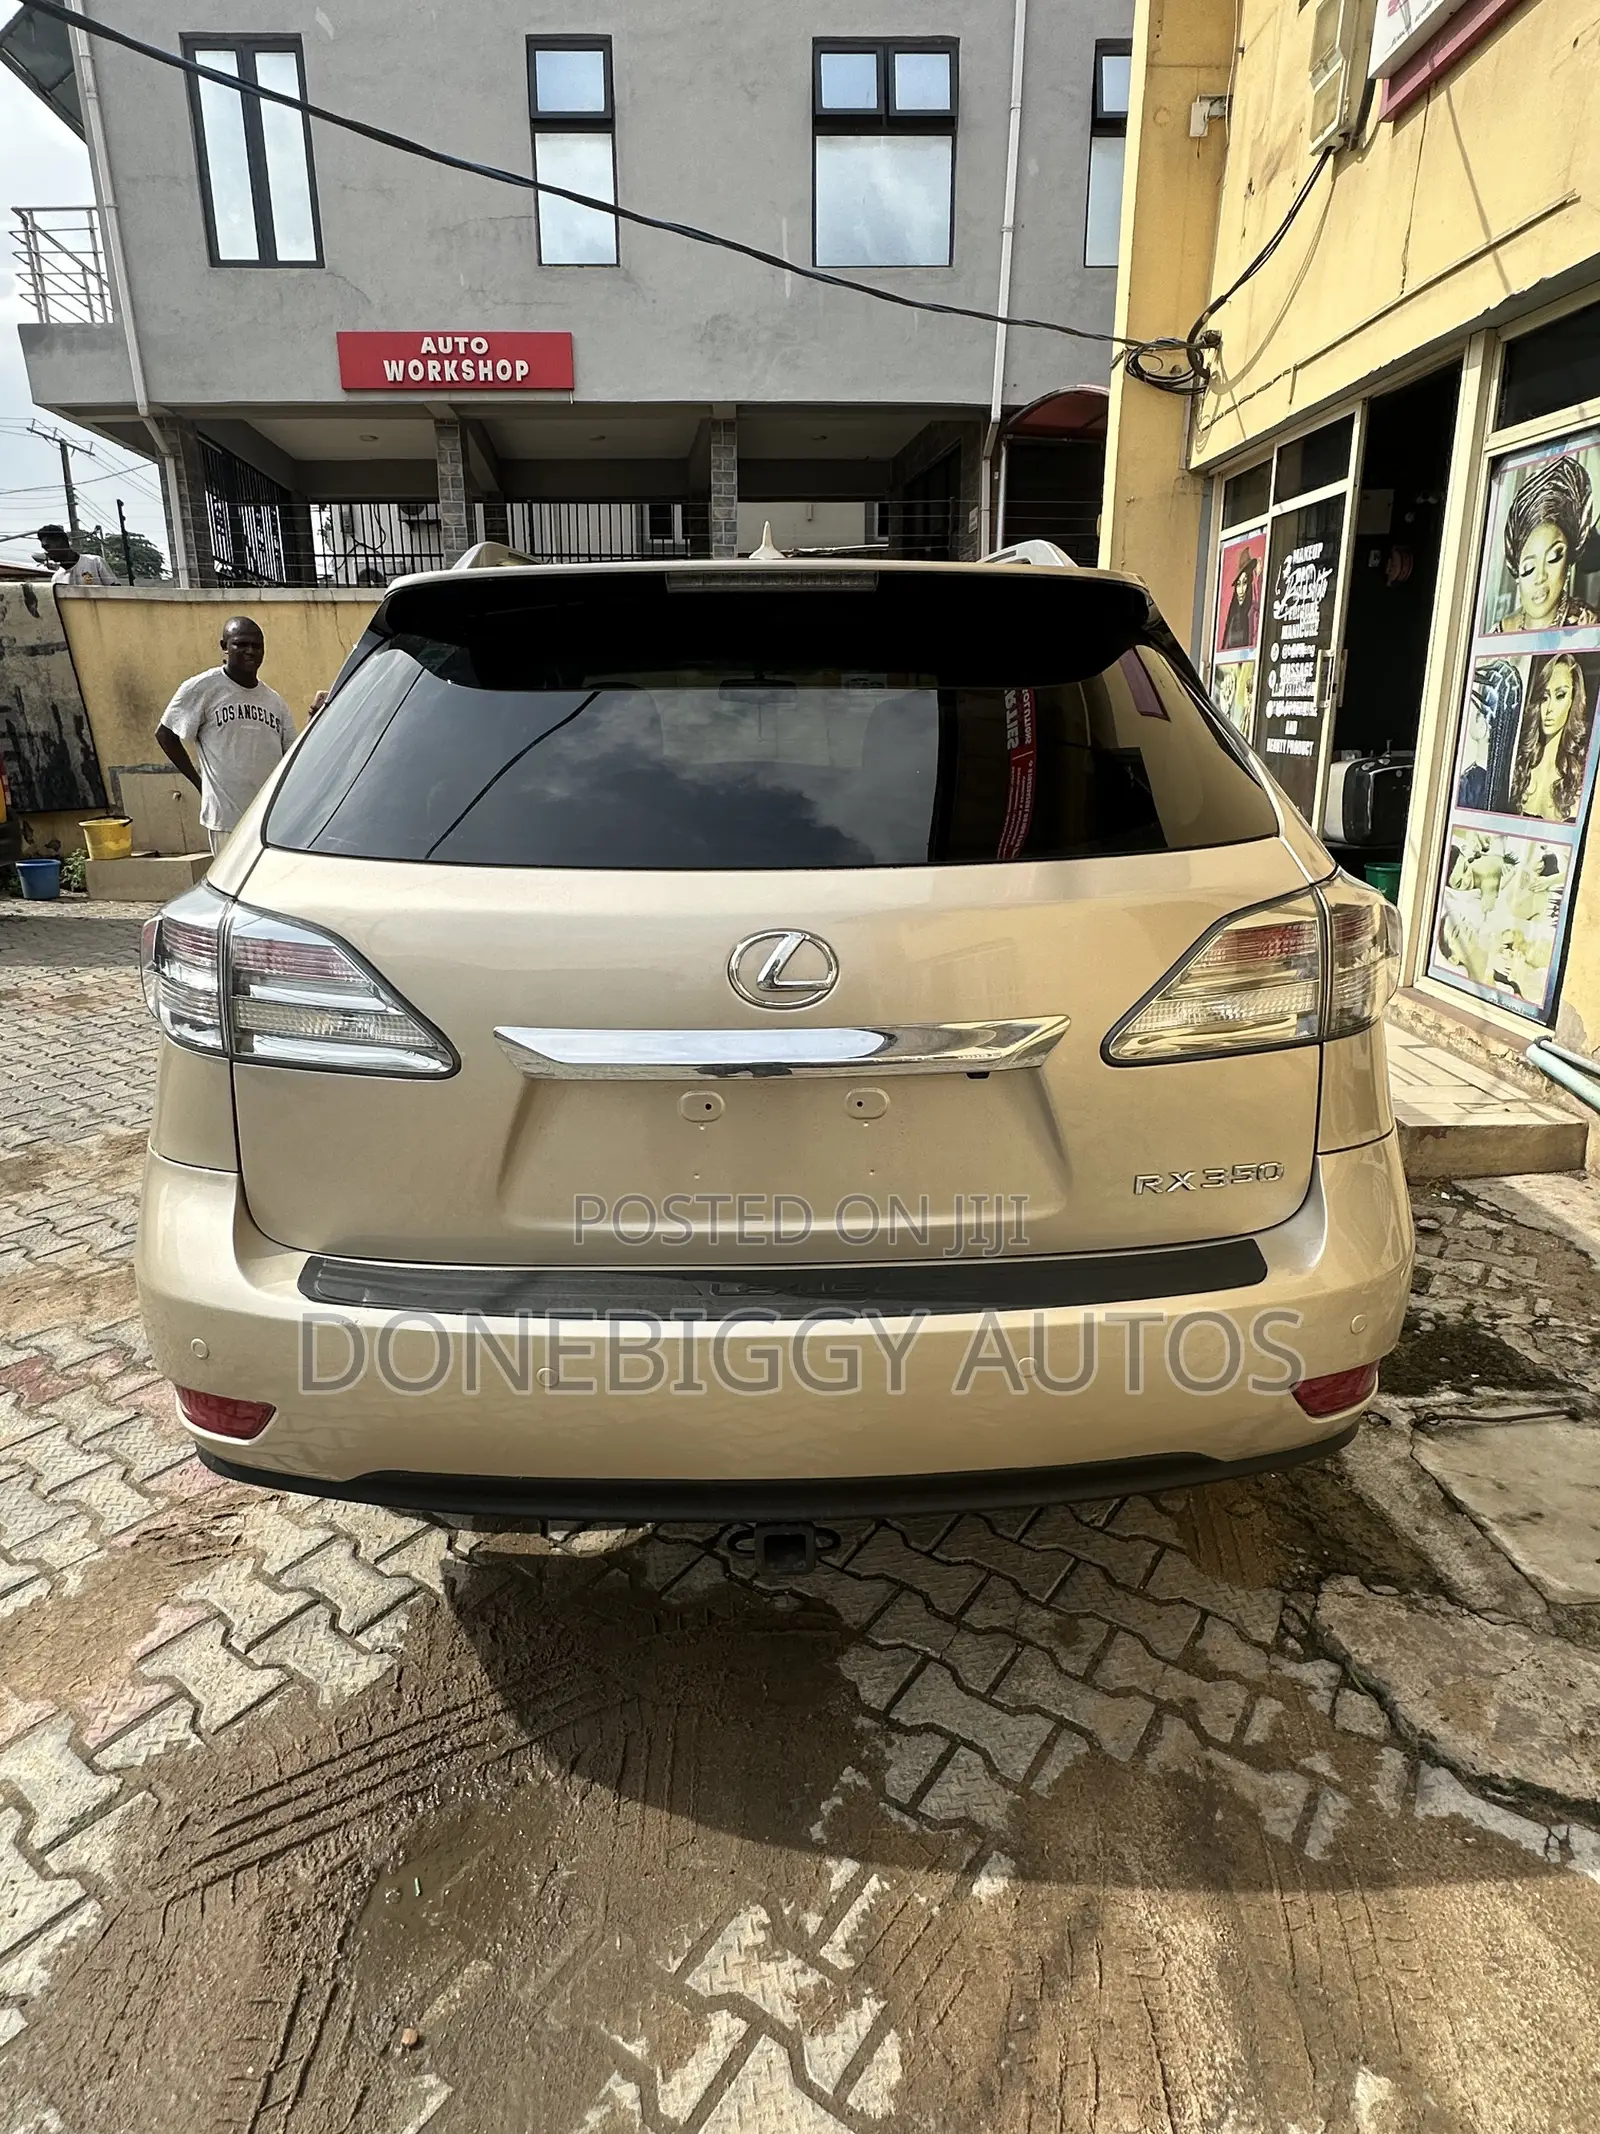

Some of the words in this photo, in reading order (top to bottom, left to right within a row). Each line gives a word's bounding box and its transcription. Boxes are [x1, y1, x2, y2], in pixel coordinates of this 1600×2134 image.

[420, 336, 489, 355] AUTO
[383, 358, 530, 382] WORKSHOP
[1292, 542, 1324, 564] MAKEUP
[215, 704, 235, 727] LOS
[237, 704, 281, 733] ANGELES
